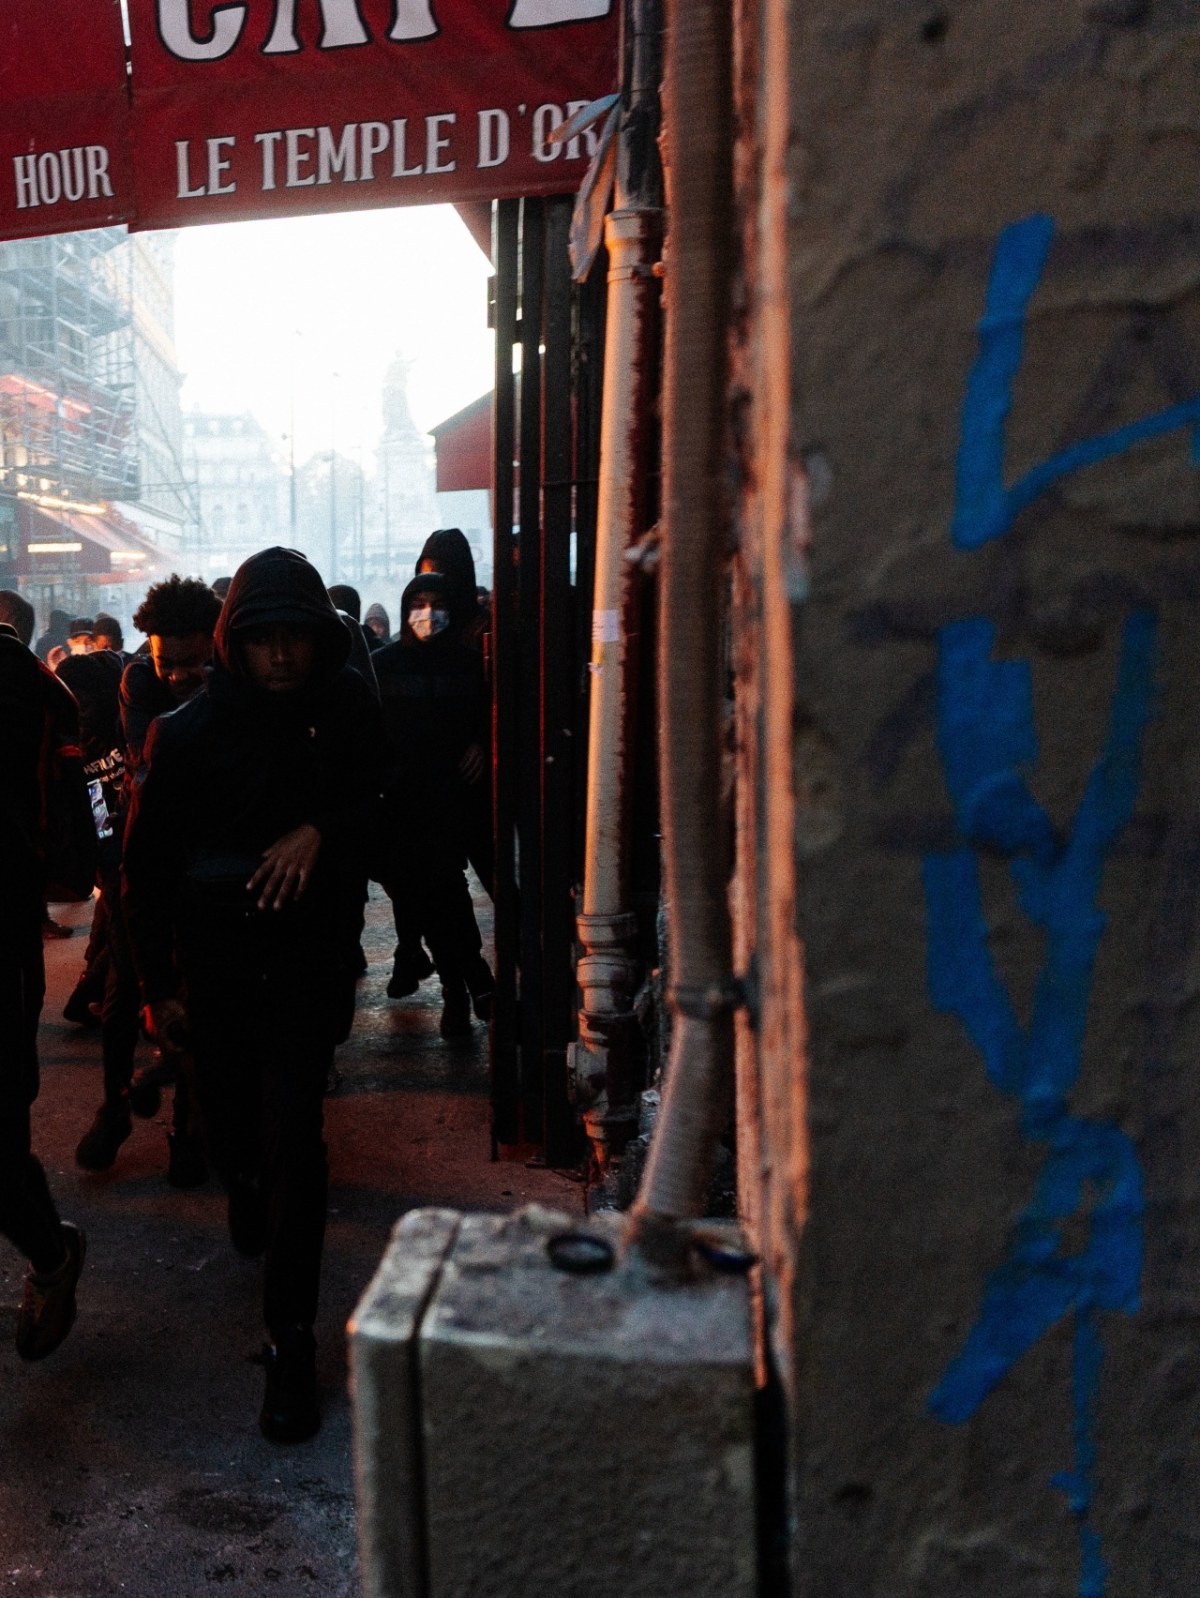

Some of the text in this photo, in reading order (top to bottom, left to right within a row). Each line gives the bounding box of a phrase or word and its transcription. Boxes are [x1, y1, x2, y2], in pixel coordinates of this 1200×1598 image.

[12, 144, 115, 210] HOUR
[174, 135, 237, 199] LE
[254, 112, 457, 191] TEMPLE
